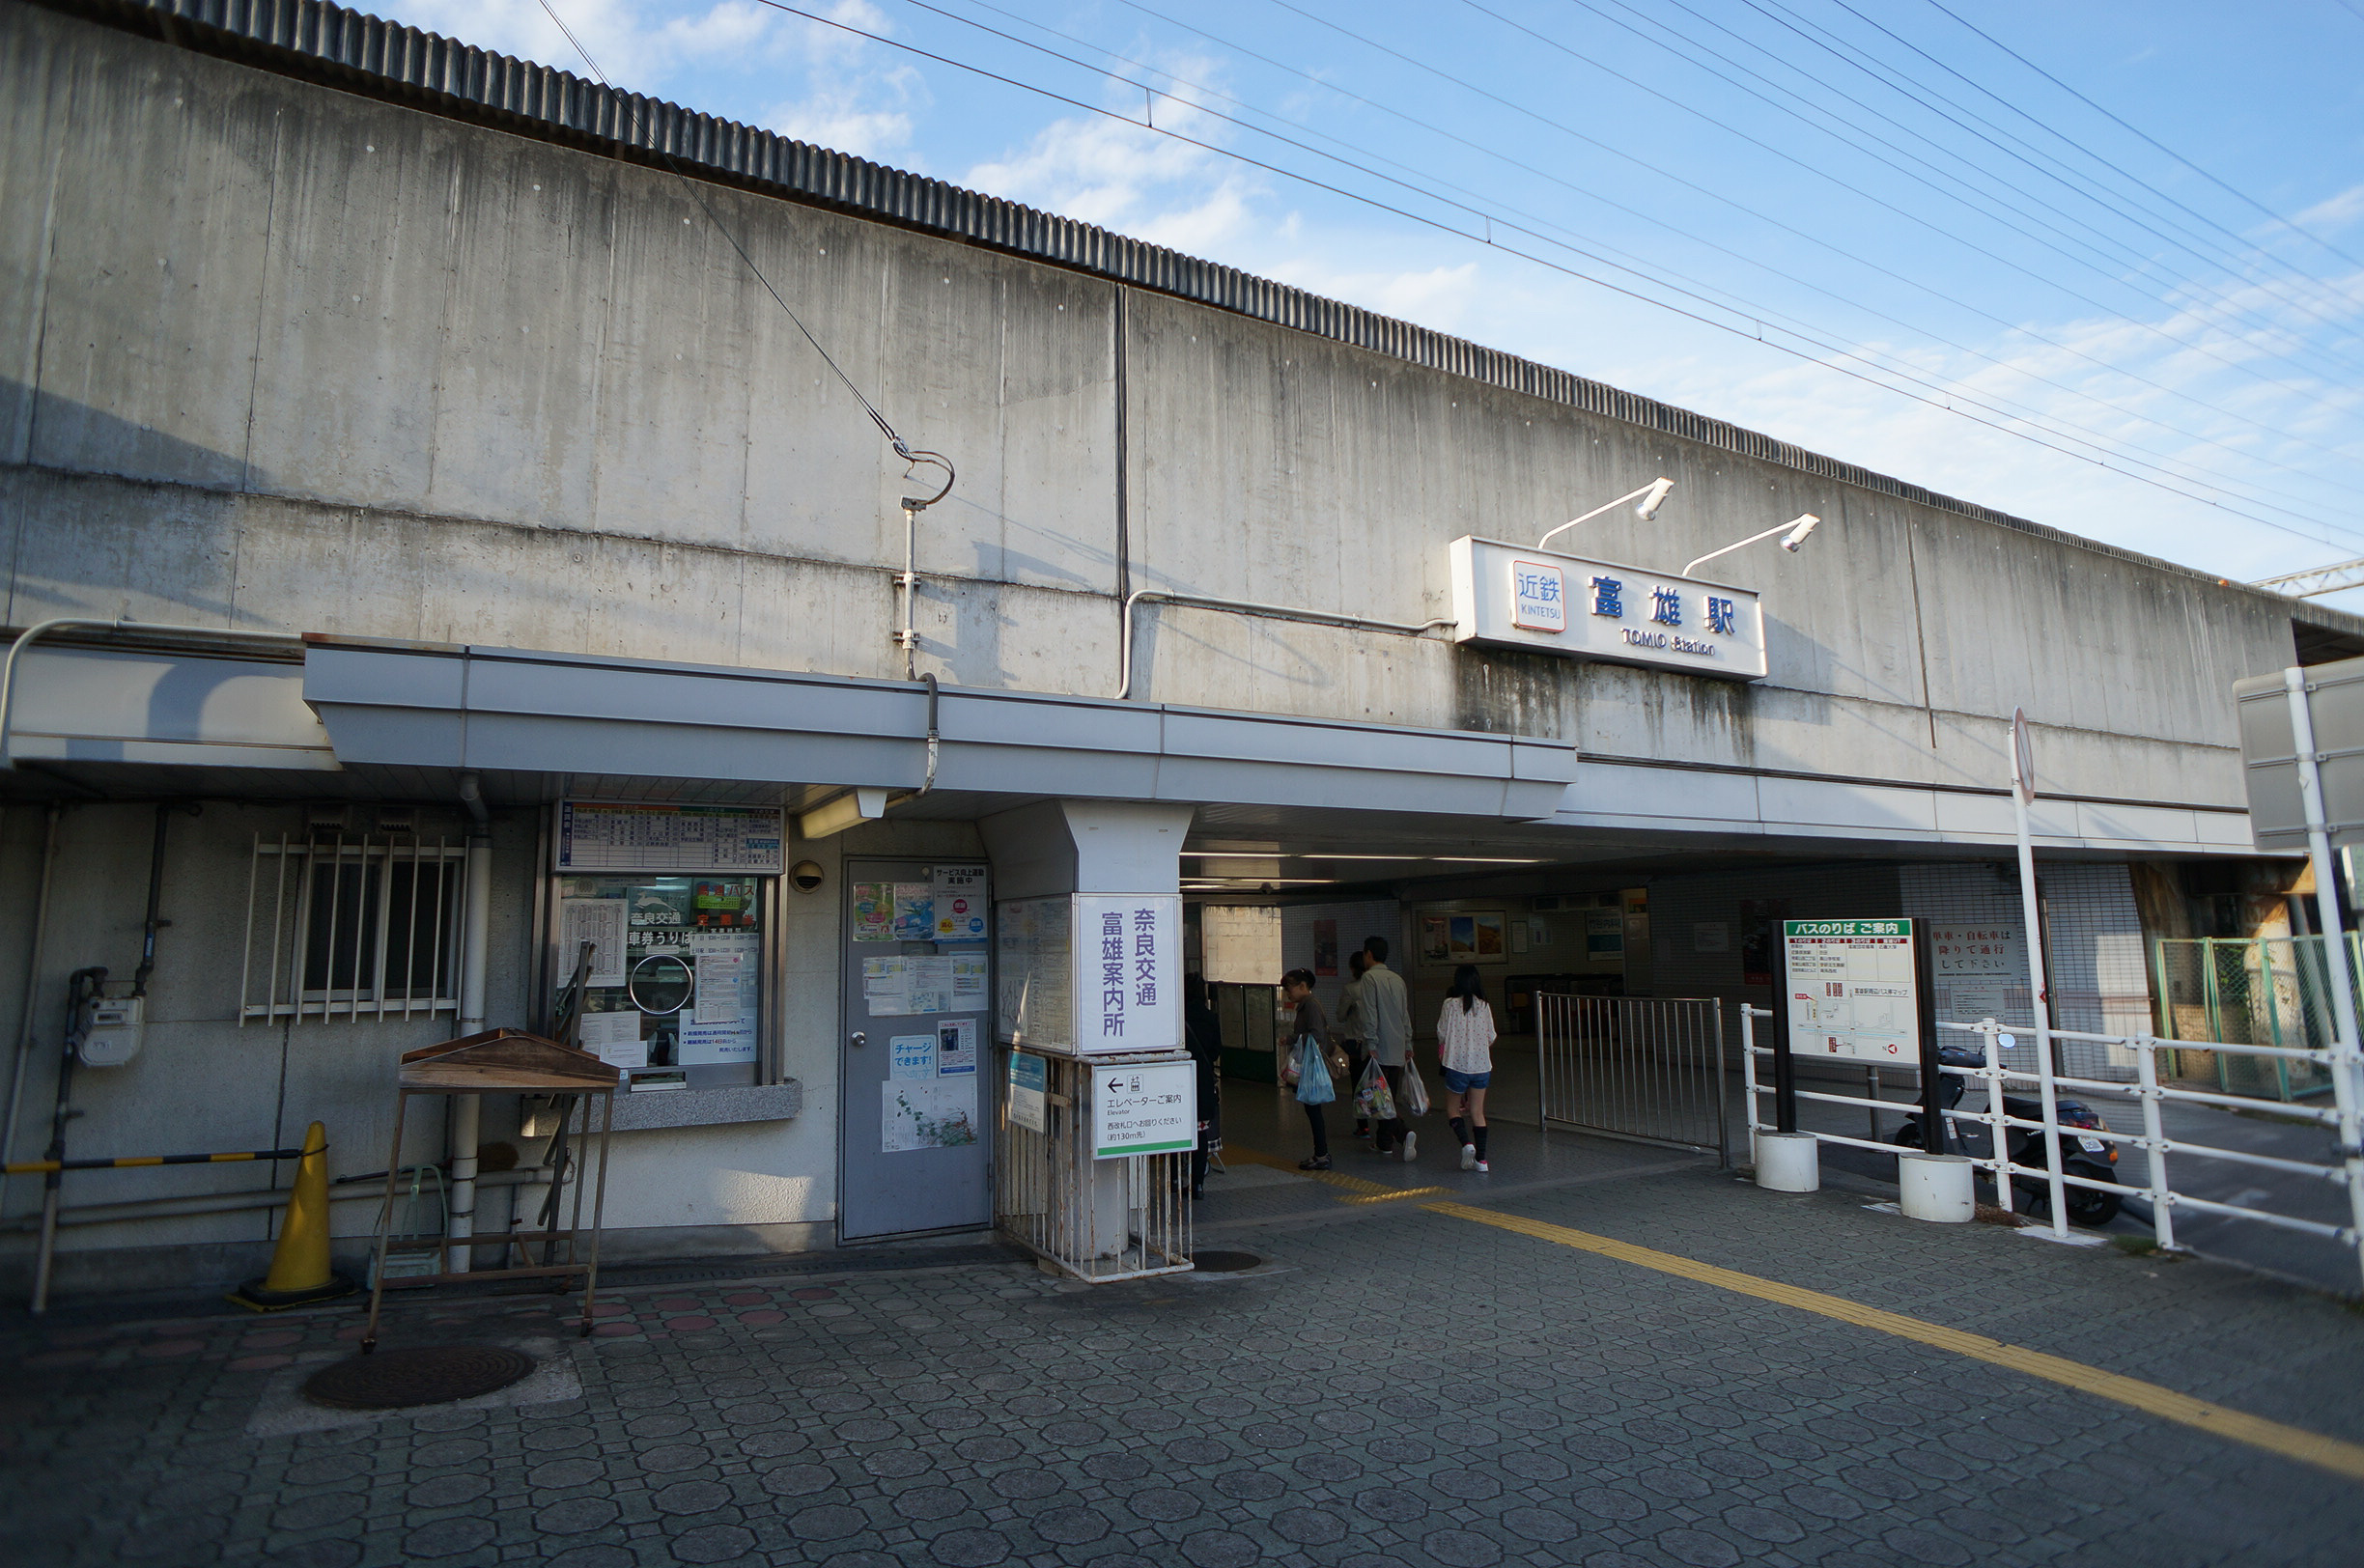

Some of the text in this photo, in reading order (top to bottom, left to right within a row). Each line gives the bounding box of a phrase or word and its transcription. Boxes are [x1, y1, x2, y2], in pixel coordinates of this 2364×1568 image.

[1518, 572, 1561, 603] 近鉄
[1521, 603, 1562, 620] KINTETSU
[1589, 574, 1735, 635] 富雄駅
[1620, 628, 1716, 657] TOMIO Station
[631, 911, 682, 924] 奈良交通
[1795, 922, 1899, 934] バスのりば ご案内
[1939, 944, 2005, 955] 降りて通行
[1134, 908, 1157, 1006] 奈良交通
[1942, 959, 2005, 969] して下さい
[1102, 911, 1125, 1037] 富雄案内所
[894, 1043, 932, 1053] チャージ
[1107, 1094, 1182, 1108] エレベーターご案内
[1107, 1117, 1182, 1131] 西改札口へお回りください
